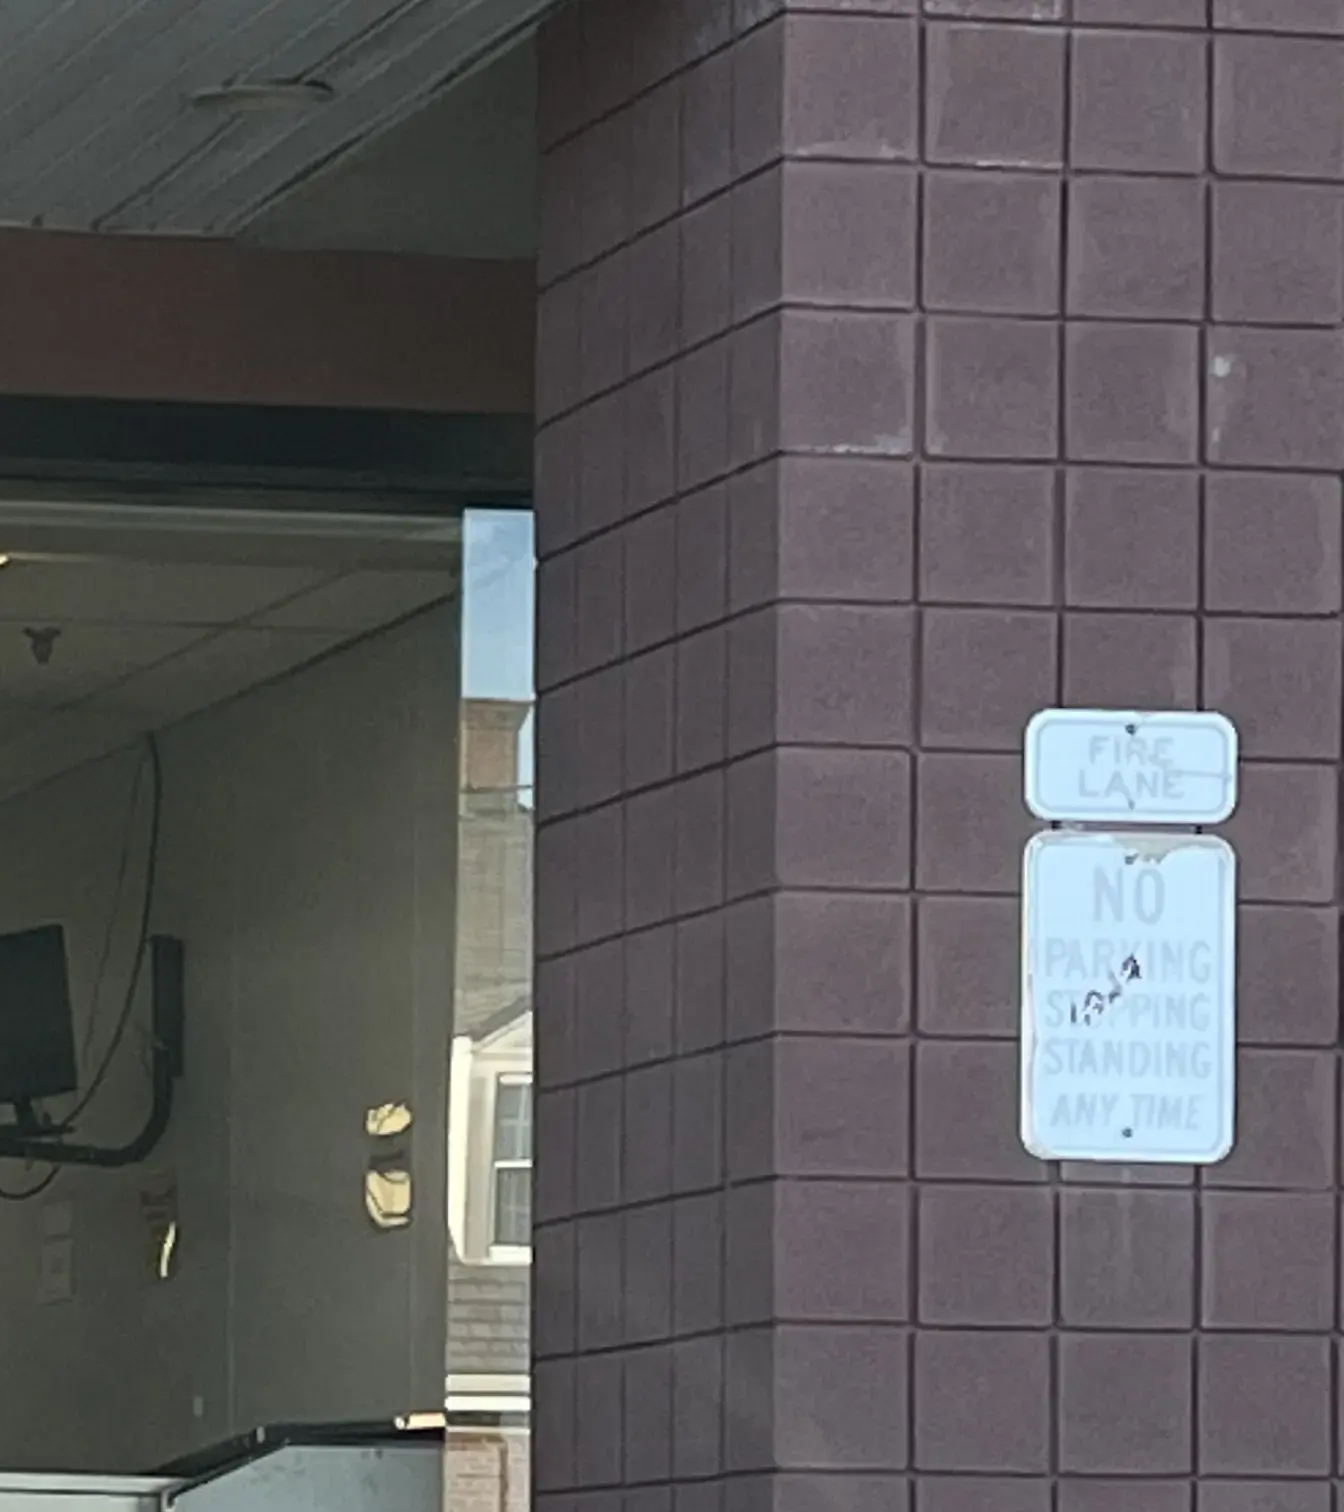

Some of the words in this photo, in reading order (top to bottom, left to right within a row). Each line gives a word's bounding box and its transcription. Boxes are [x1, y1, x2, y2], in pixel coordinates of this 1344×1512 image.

[1088, 734, 1175, 768] FIRE
[1078, 768, 1185, 801] LANE
[1092, 865, 1167, 927] NO
[1045, 936, 1212, 983] PARKING
[1042, 1038, 1212, 1079] STANDING
[1049, 1092, 1119, 1129] ANY
[1130, 1093, 1205, 1131] TIME
